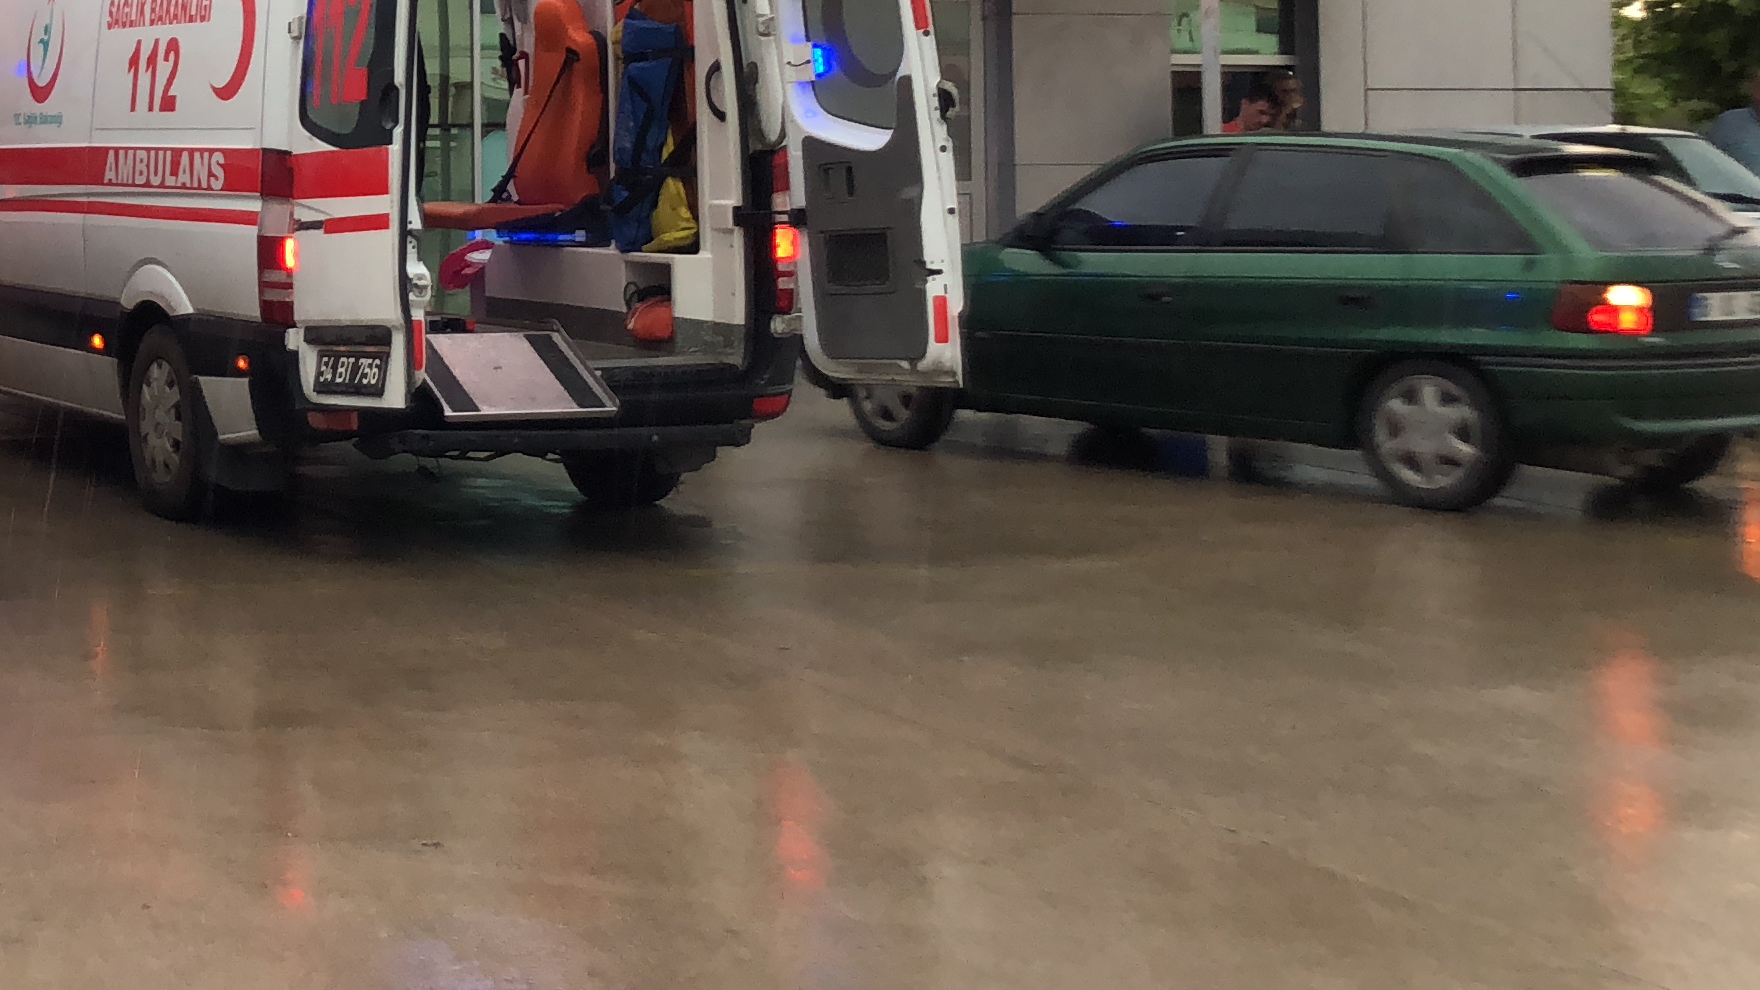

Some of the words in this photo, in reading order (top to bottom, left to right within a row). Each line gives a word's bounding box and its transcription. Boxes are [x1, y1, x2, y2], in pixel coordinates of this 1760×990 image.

[127, 37, 180, 112] 112
[103, 149, 225, 191] AMBULANS
[319, 356, 335, 383] 54
[334, 356, 356, 384] BT
[354, 357, 381, 385] 756
